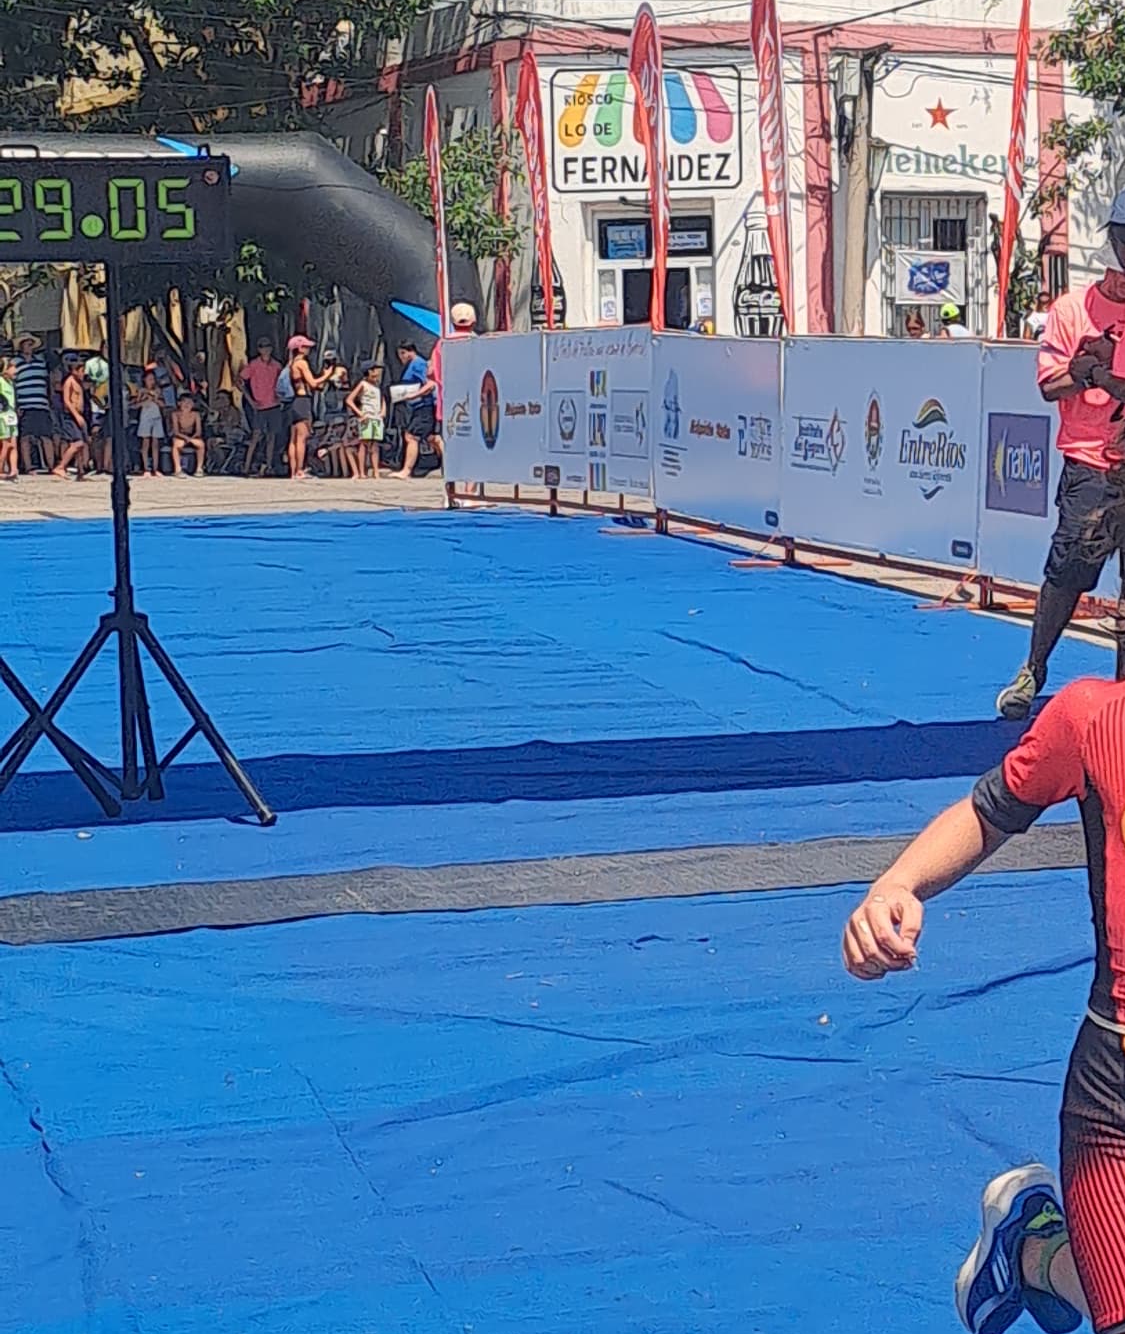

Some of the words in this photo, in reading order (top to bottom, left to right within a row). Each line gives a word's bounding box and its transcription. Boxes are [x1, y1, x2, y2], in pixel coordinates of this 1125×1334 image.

[564, 93, 613, 107] KIOSCO
[564, 123, 586, 137] LO
[593, 122, 613, 136] DE
[563, 153, 731, 184] FERNNDEZ
